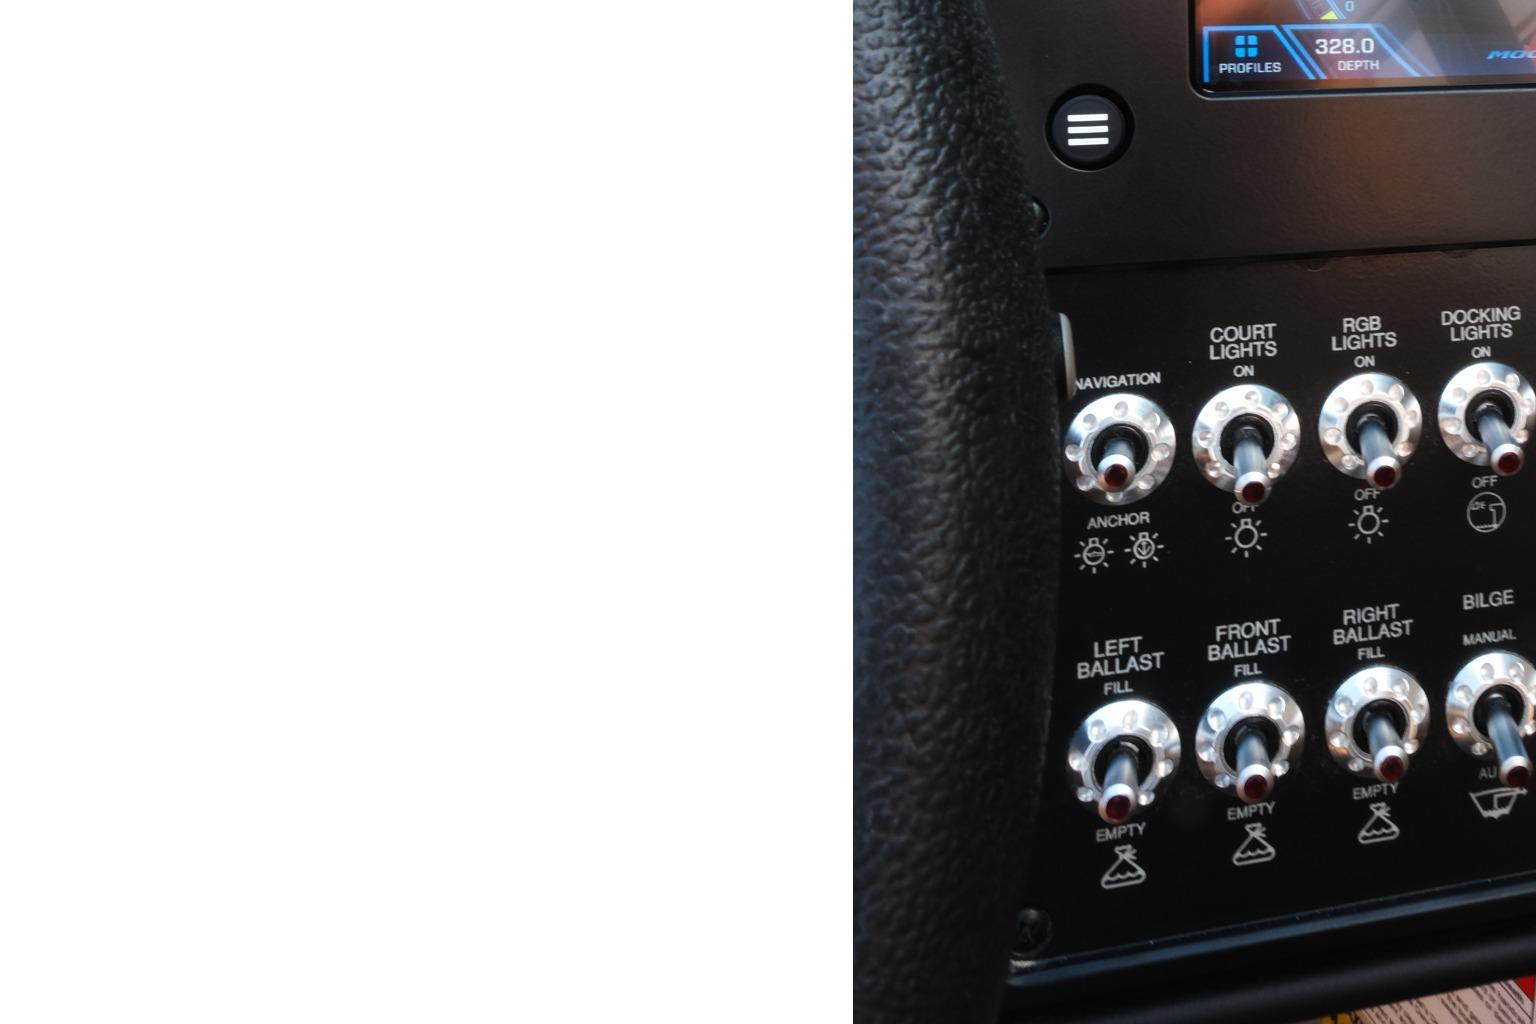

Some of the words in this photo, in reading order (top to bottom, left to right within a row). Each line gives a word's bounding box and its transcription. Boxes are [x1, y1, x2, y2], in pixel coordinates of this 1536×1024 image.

[1344, 0, 1355, 12] 0
[1315, 38, 1375, 55] 328.0
[1218, 61, 1282, 74] PROFILES
[1338, 59, 1379, 72] DEPTH
[1342, 315, 1382, 334] RGB
[1441, 305, 1521, 326] DOCKING
[1209, 323, 1277, 343] COURT
[1331, 332, 1398, 352] LIGHTS
[1450, 323, 1513, 342] LIGHTS
[1209, 341, 1278, 361] LIGHTS
[1471, 346, 1492, 359] ON
[1233, 364, 1255, 378] ON
[1354, 355, 1376, 369] ON
[1075, 371, 1162, 391] NAVIGATION
[1472, 474, 1498, 489] OFF
[1354, 487, 1381, 501] OFF
[1087, 511, 1151, 530] ANCHOR
[1462, 589, 1515, 610] BILGE
[1343, 603, 1400, 625] RIGHT
[1216, 618, 1281, 642] FRONT
[1332, 619, 1414, 645] BALLAST
[1462, 628, 1517, 646] MANUAL
[1093, 636, 1143, 659] LEFT
[1207, 635, 1292, 661] BALLAST
[1357, 646, 1385, 661] FILL
[1076, 652, 1165, 680] BALLAST
[1234, 663, 1263, 677] FILL
[1104, 680, 1134, 696] FILL
[1352, 782, 1399, 801] EMPTY
[1227, 801, 1276, 822] EMPTY
[1096, 822, 1147, 843] EMPTY
